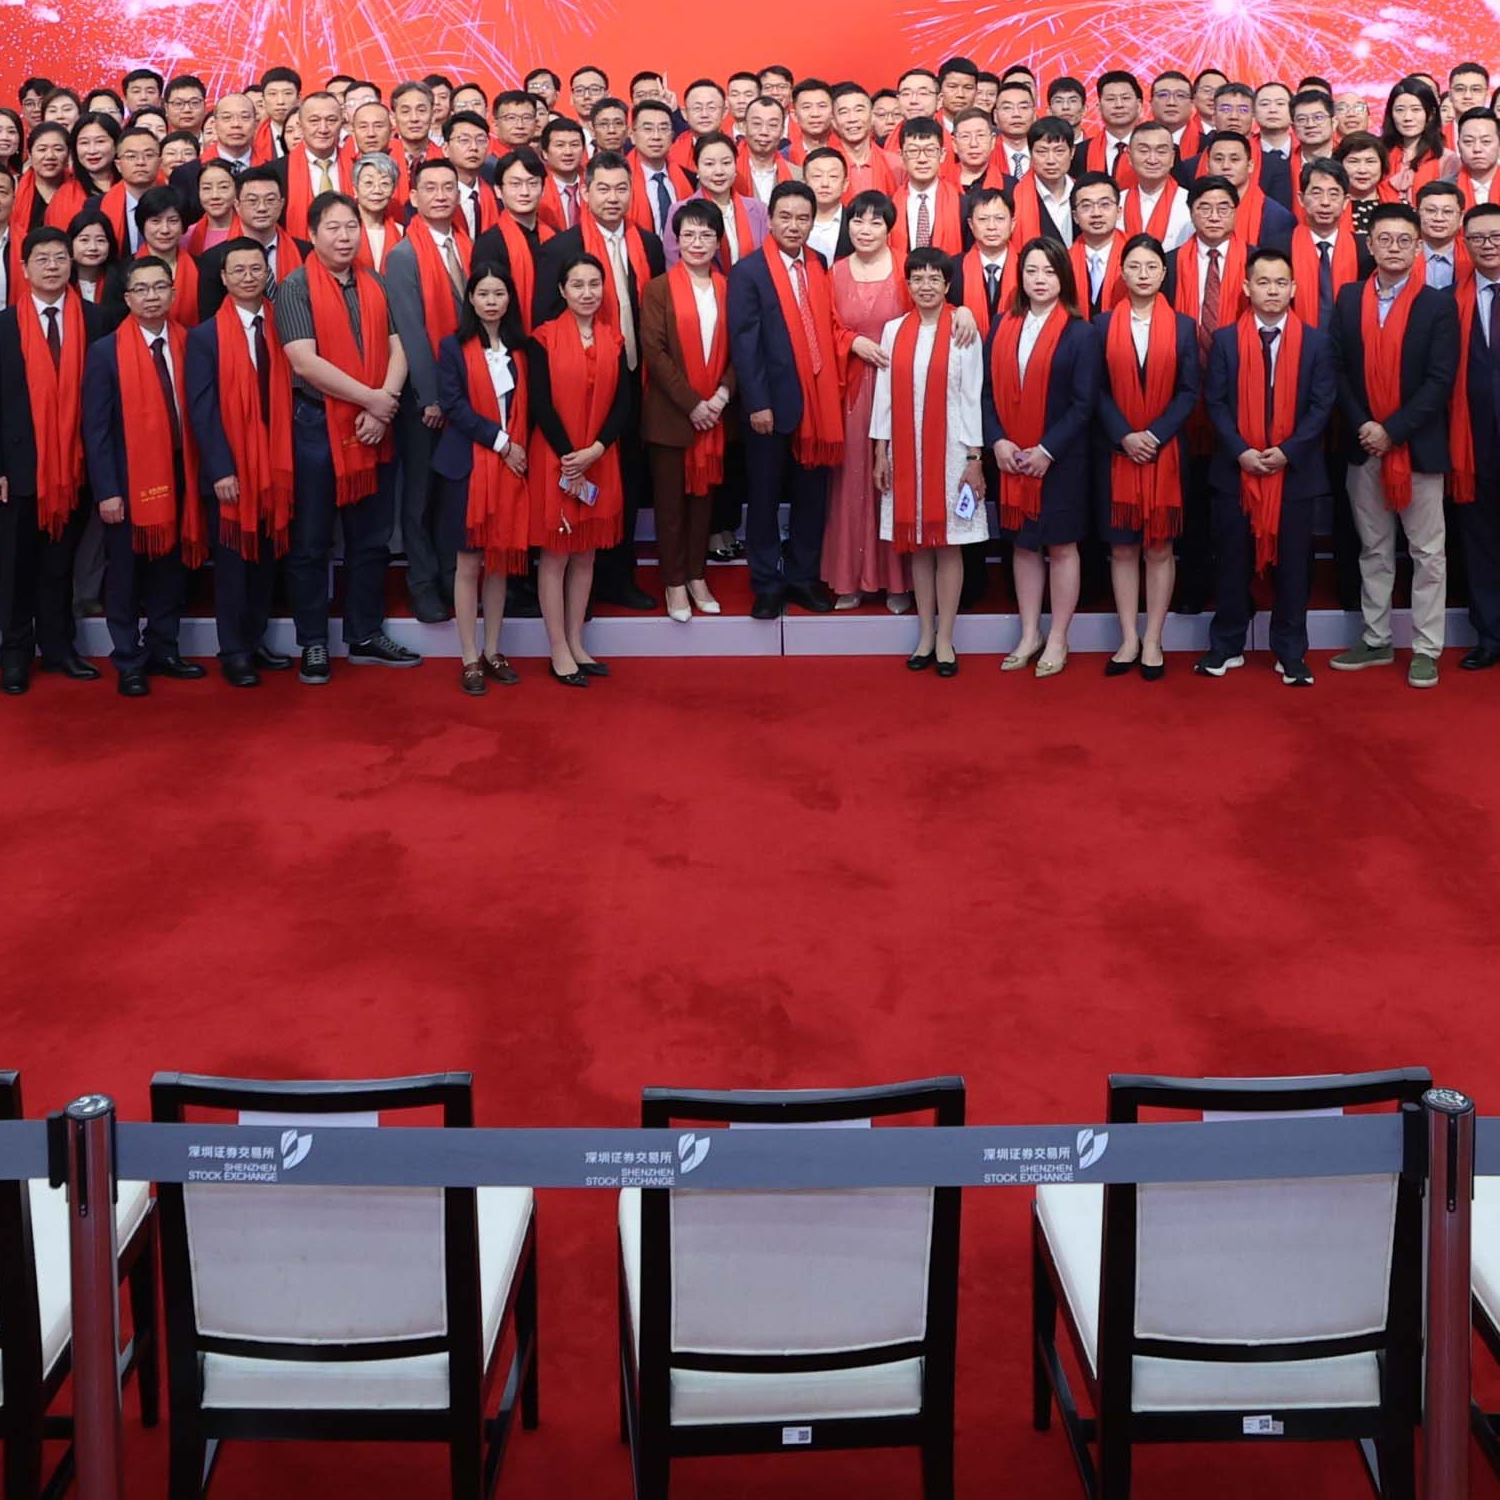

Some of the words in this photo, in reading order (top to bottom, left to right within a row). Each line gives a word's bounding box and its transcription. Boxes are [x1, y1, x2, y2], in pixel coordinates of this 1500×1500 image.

[188, 1145, 275, 1159] 深圳证券交易所
[585, 1151, 672, 1164] 深圳证券交易所
[983, 1147, 1071, 1161] 深圳证券交易所
[224, 1163, 277, 1172] SHENZHEN
[621, 1168, 674, 1177] SHENZHEN
[1020, 1164, 1073, 1173] SHENZHEN
[188, 1170, 221, 1180] STOCK
[224, 1172, 277, 1181] EXCHANGE
[586, 1176, 618, 1186] STOCK
[621, 1177, 675, 1186] EXCHANGE
[984, 1173, 1017, 1183] STOCK
[1020, 1172, 1074, 1182] EXCHANGE
